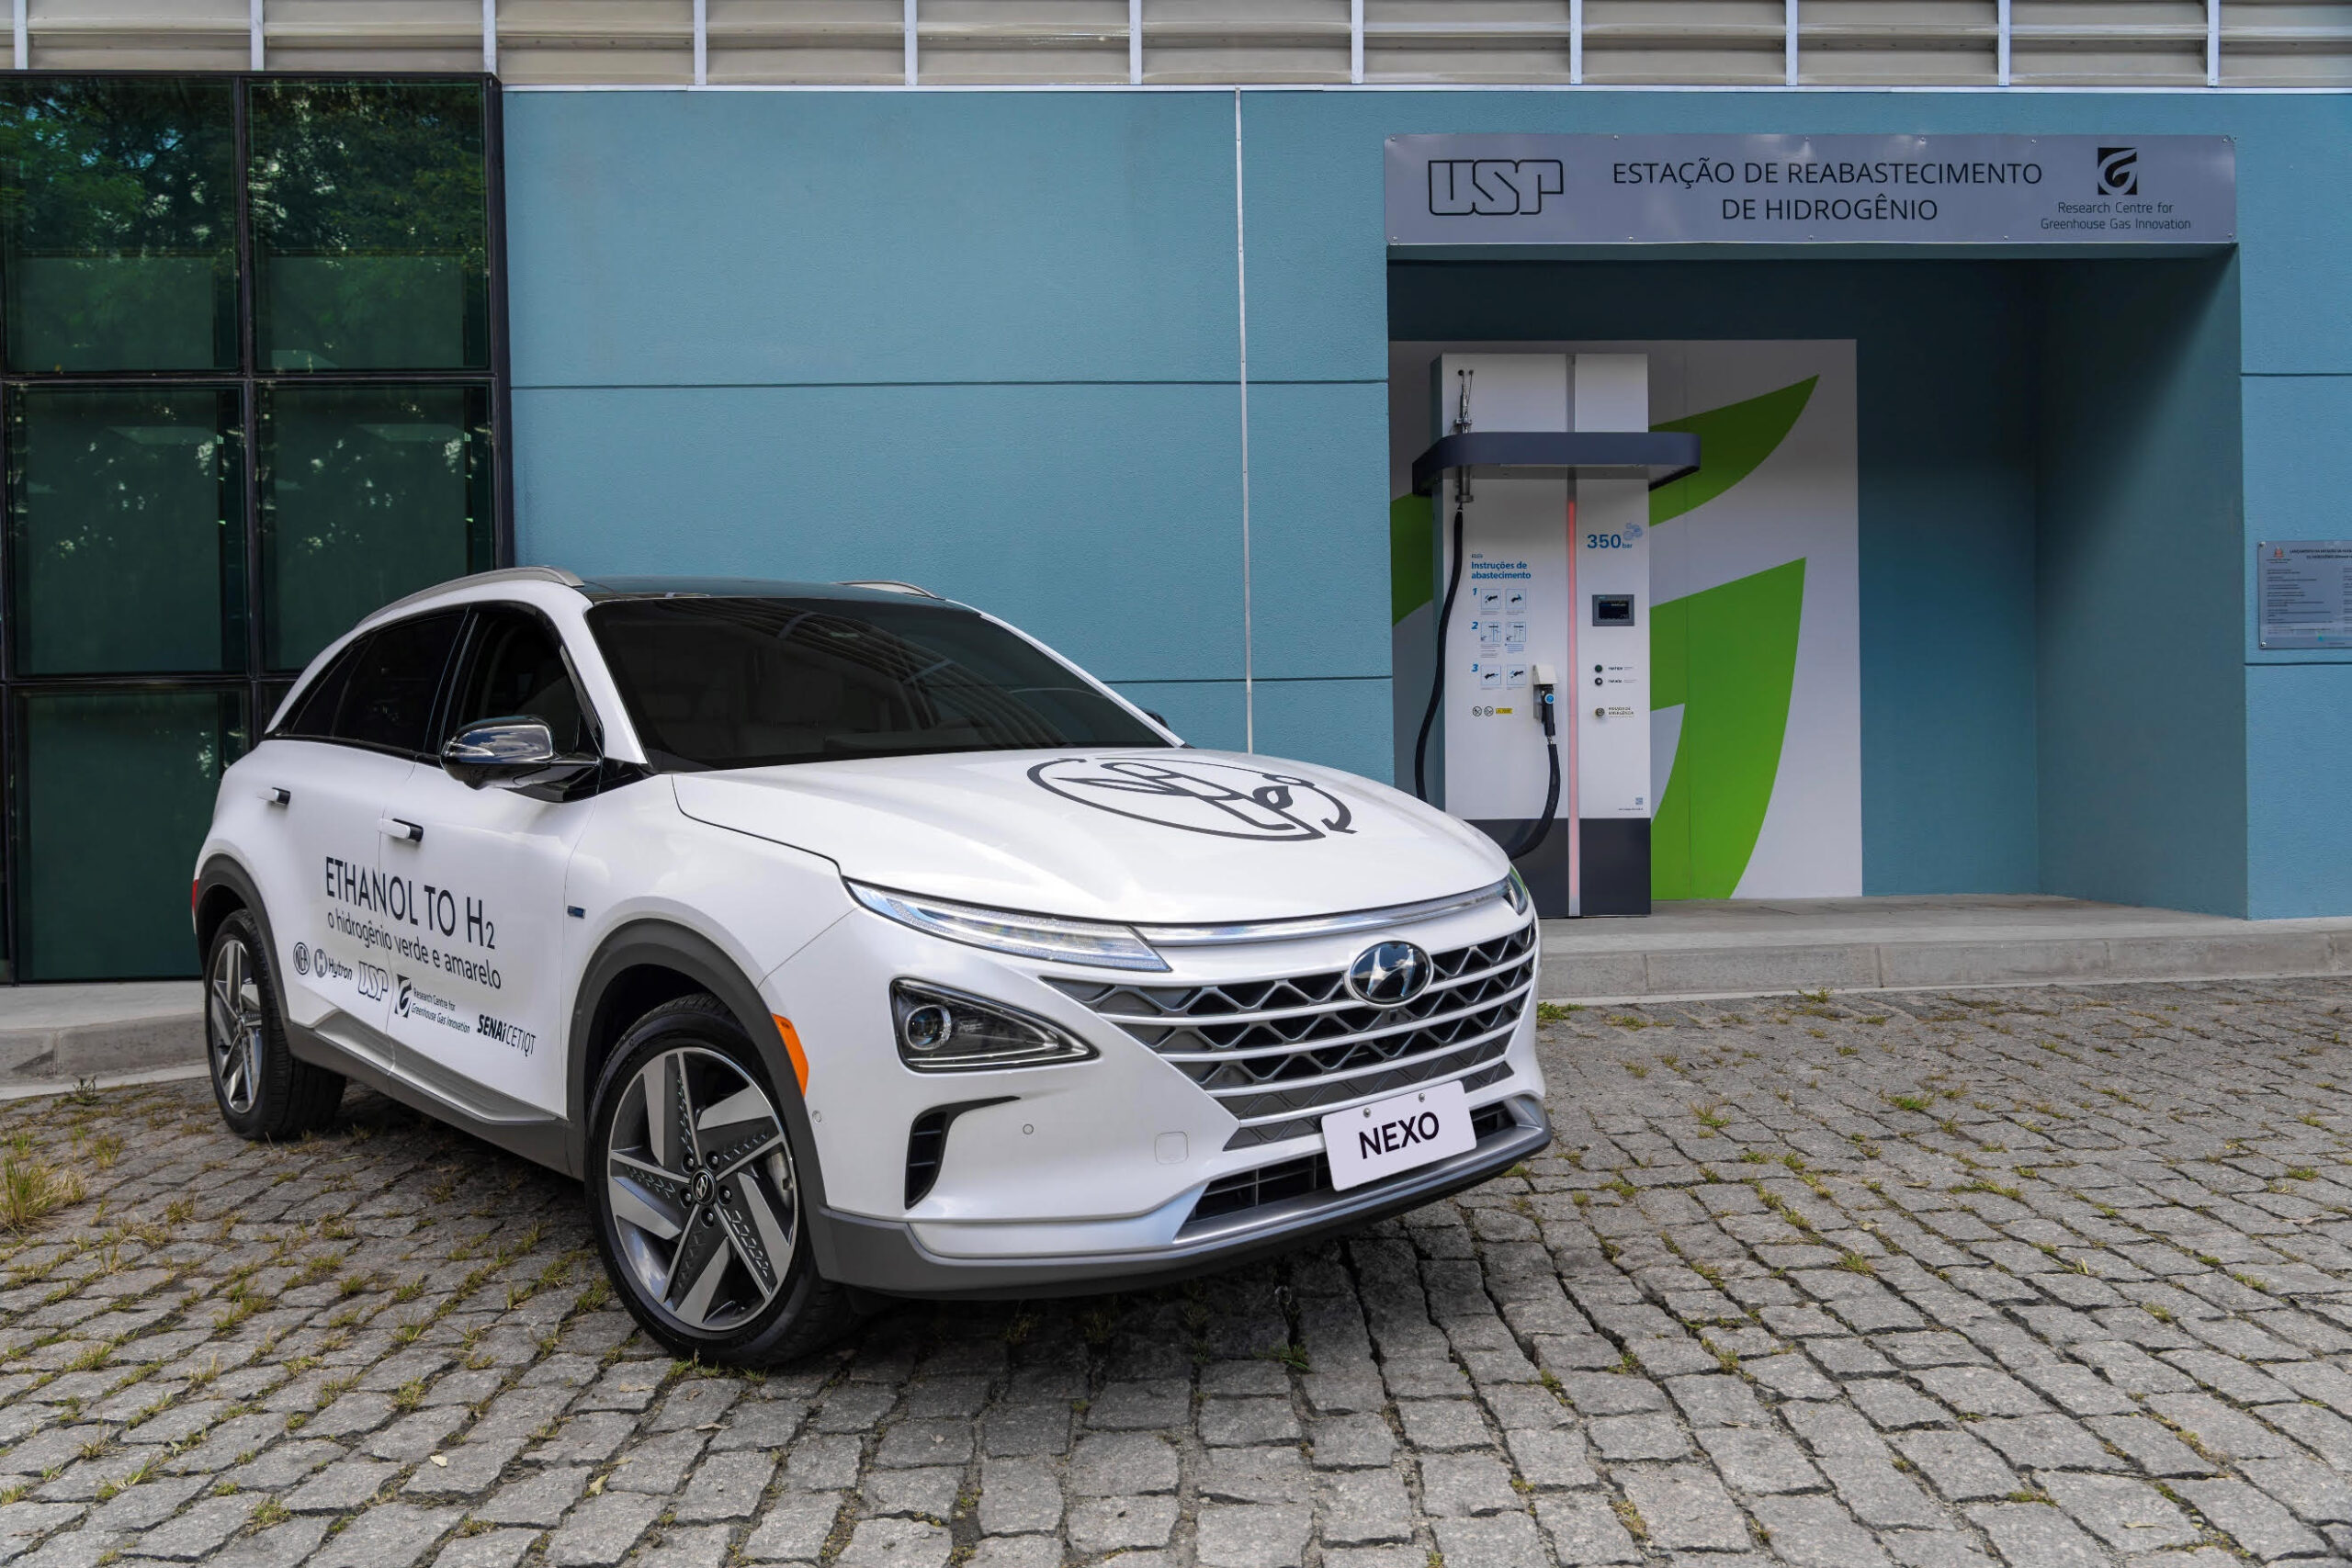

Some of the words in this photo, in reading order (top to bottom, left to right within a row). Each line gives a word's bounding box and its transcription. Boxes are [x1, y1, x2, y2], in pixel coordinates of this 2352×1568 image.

[1612, 157, 1735, 189] ESTAÇÃO
[1746, 163, 1779, 184] DE
[1789, 163, 2042, 184] REABASTECIMENTO
[1429, 159, 1564, 216] USP
[1723, 198, 1756, 220] DE
[1766, 194, 1938, 220] HIDROGÊNIO
[2058, 202, 2110, 214] Research
[2115, 202, 2153, 214] Centre
[2157, 202, 2174, 214] for
[2041, 218, 2106, 230] Greenhouse
[2109, 218, 2132, 230] Gas
[2135, 218, 2191, 230] Innovation
[1587, 534, 1622, 548] 350
[1471, 560, 1515, 570] Instruções
[1516, 560, 1528, 570] de
[1471, 570, 1532, 580] abastecimento
[1472, 588, 1478, 596] 1
[1471, 621, 1479, 630] 2
[1471, 663, 1479, 672] 3
[326, 856, 419, 926] ETHANOL
[424, 885, 456, 937] TO
[327, 911, 334, 929] o
[335, 908, 392, 951] hidrogênio
[394, 935, 429, 964] verde
[432, 949, 441, 968] e
[445, 953, 502, 990] amarelo
[328, 957, 353, 981] Hytron
[358, 961, 389, 1002] USP
[413, 987, 433, 1003] Research
[433, 995, 447, 1010] Centre
[448, 1000, 457, 1011] for
[411, 1002, 436, 1021] Greenhouse
[436, 1013, 447, 1025] Gas
[1359, 1111, 1440, 1159] NEXO
